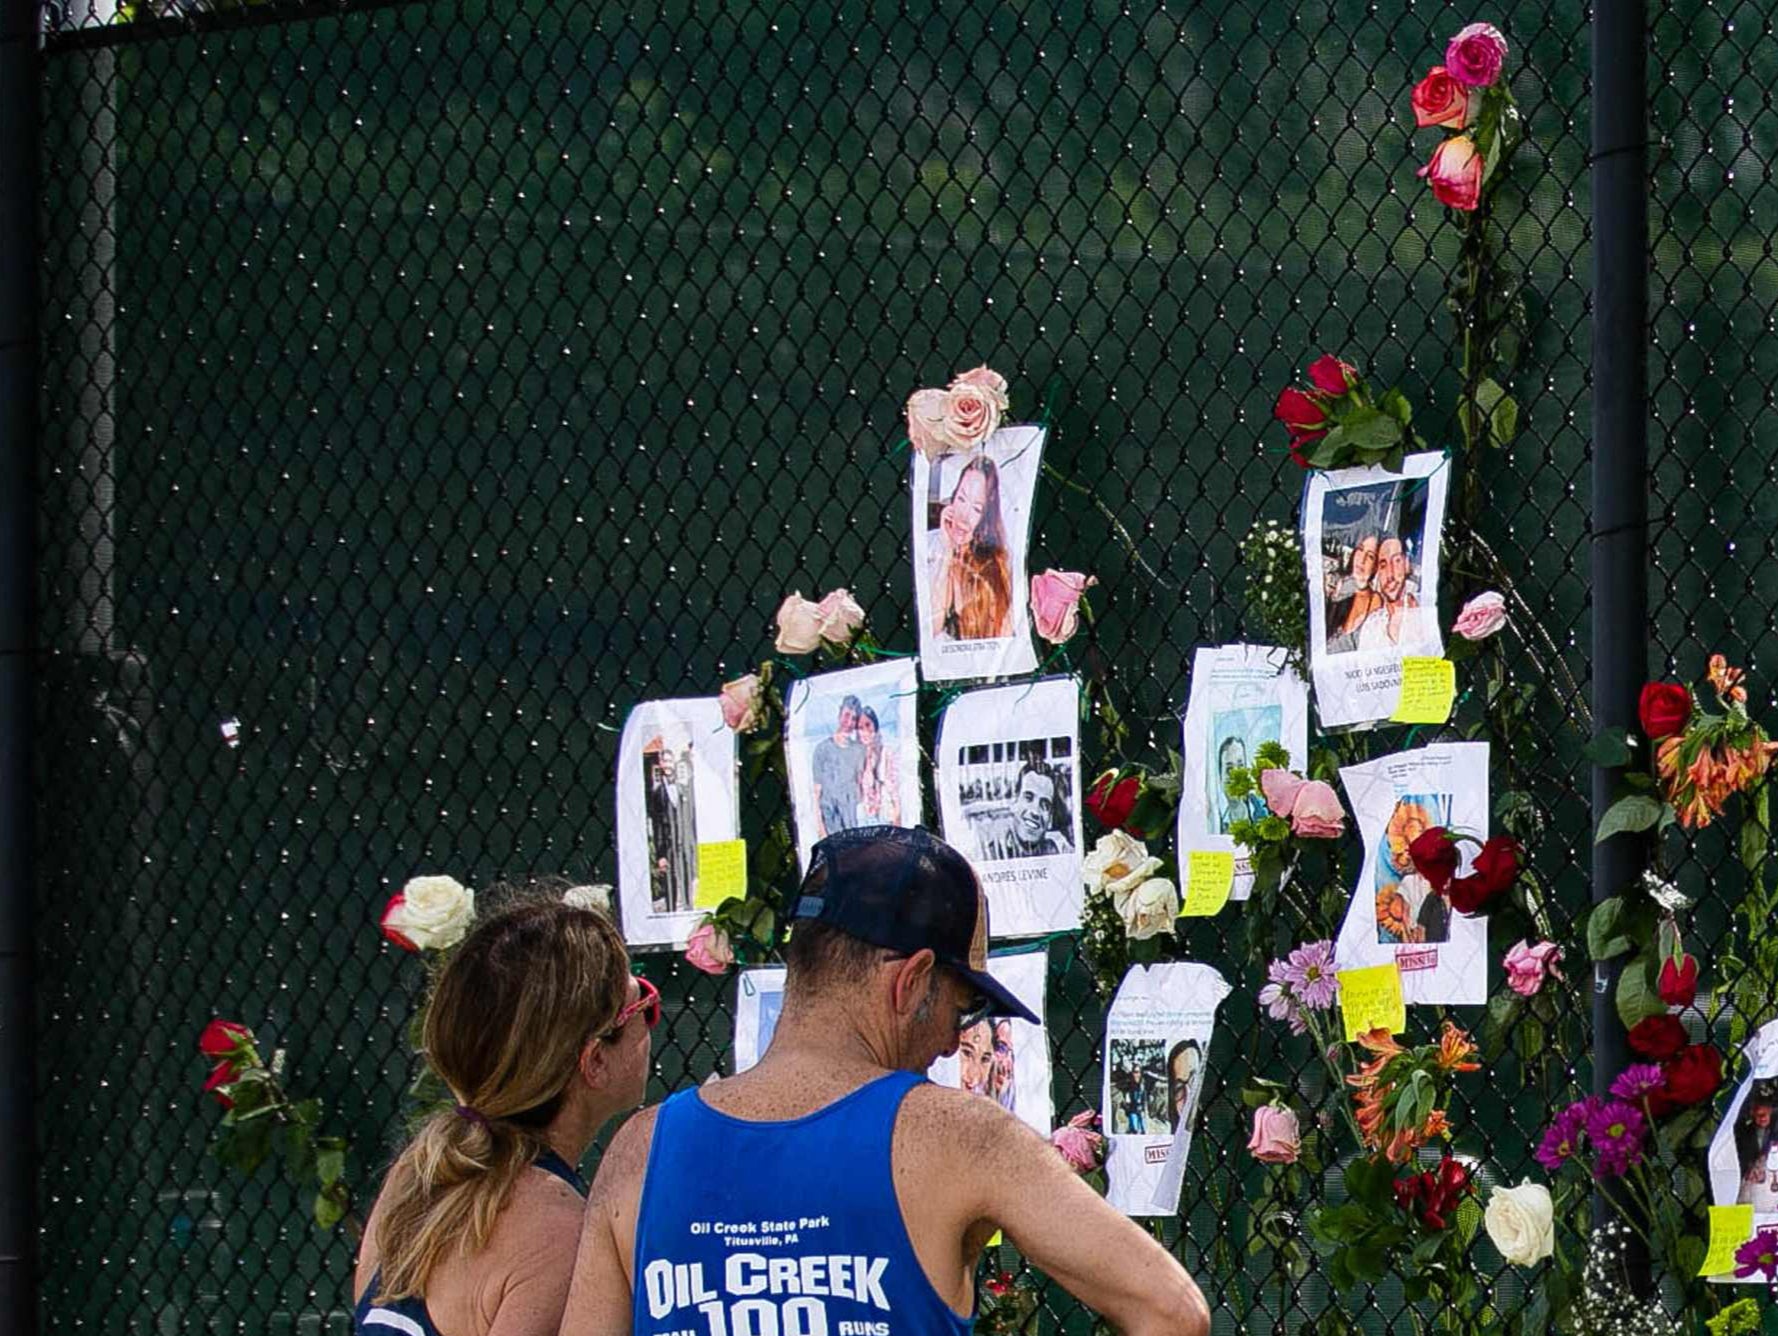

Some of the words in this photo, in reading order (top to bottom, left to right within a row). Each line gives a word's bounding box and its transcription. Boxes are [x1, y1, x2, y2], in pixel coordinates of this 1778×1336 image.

[690, 1221, 711, 1235] Oil
[714, 1221, 757, 1234] Creek
[761, 1219, 797, 1233] State
[799, 1215, 829, 1230] Park
[724, 1235, 782, 1248] Titusville,
[785, 1234, 799, 1245] PA
[644, 1258, 718, 1320] OIL
[725, 1252, 891, 1312] CREEK
[838, 1320, 890, 1336] RUNS
